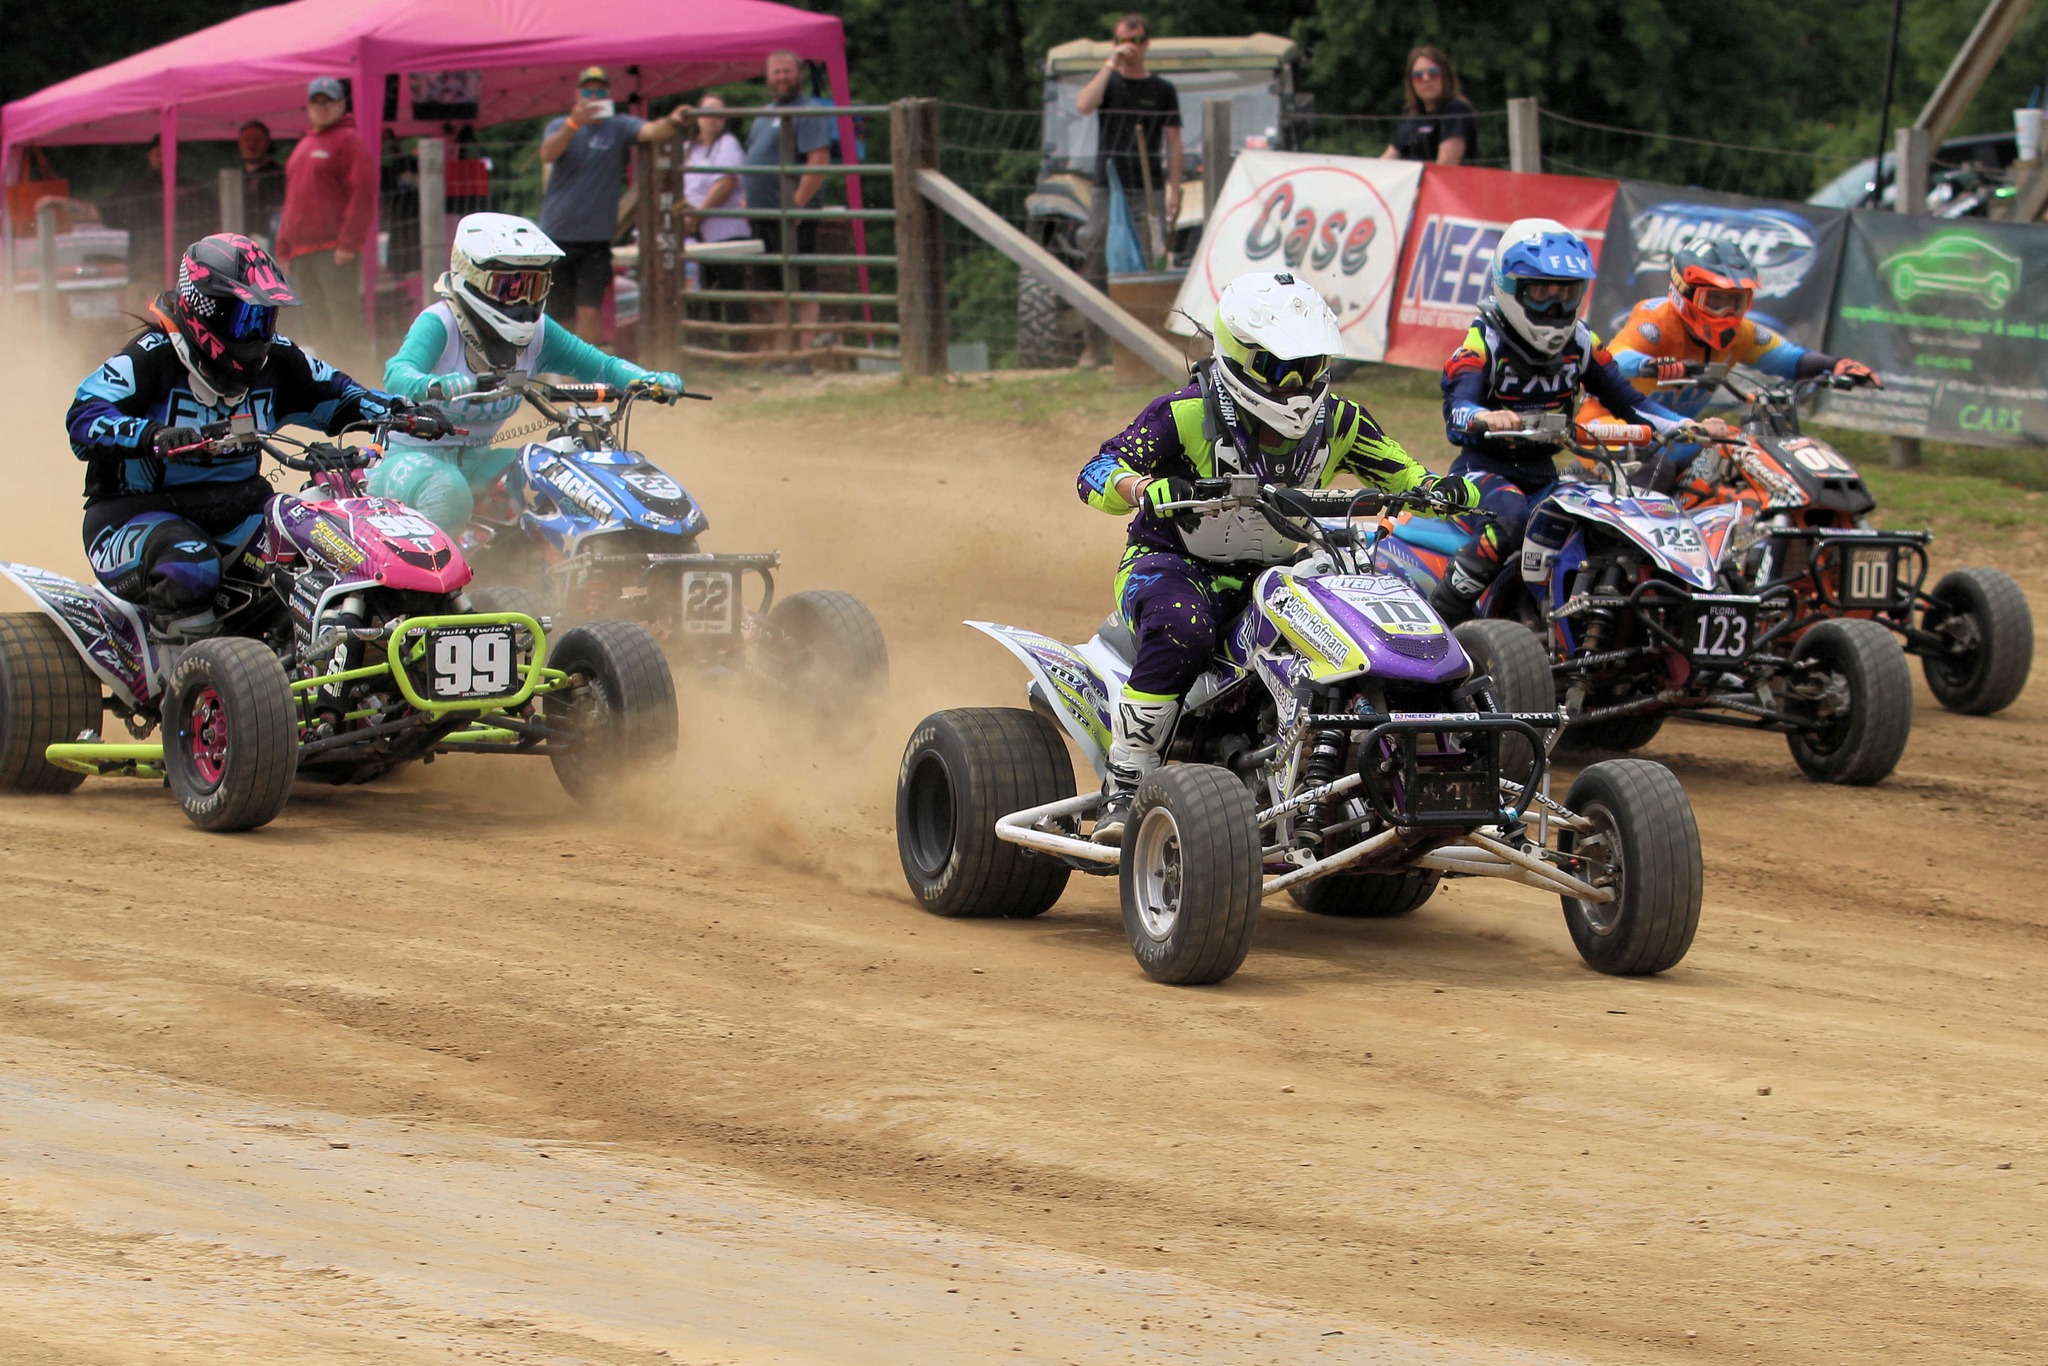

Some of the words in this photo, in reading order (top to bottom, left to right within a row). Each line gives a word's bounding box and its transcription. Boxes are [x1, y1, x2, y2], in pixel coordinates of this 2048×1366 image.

[1245, 181, 1376, 276] Case
[1549, 255, 1588, 271] FLY
[1958, 404, 2023, 434] CARS
[366, 515, 435, 537] 99
[1649, 526, 1701, 551] 123
[315, 521, 365, 565] SCHAEFFER
[1331, 579, 1374, 590] DYER
[1852, 561, 1888, 598] 00
[685, 580, 727, 620] 22
[1365, 601, 1431, 624] 10
[1710, 608, 1736, 616] FLORA
[430, 629, 466, 637] Paula
[1287, 598, 1308, 622] John
[1306, 615, 1348, 659] Hofmann
[1290, 618, 1321, 650] Performance
[1692, 615, 1748, 658] 123
[434, 632, 511, 696] 99
[1512, 712, 1553, 720] RATH
